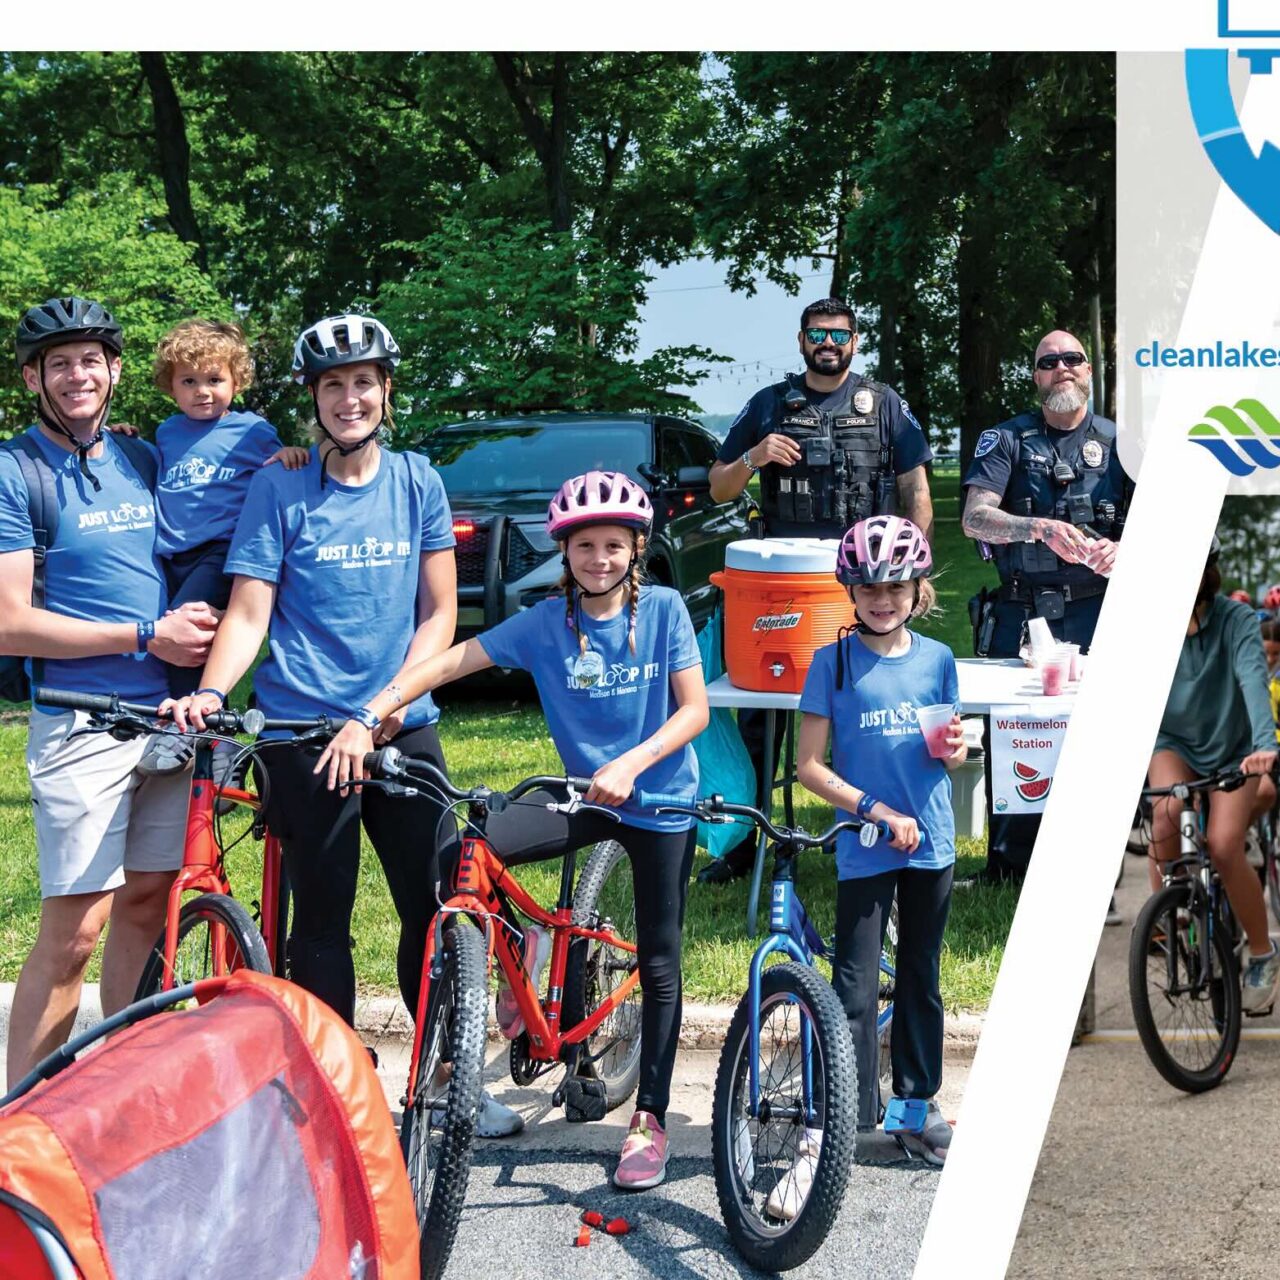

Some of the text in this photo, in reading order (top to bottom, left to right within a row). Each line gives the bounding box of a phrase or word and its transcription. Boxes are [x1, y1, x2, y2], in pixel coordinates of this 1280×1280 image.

[178, 463, 215, 478] LOOP
[78, 509, 109, 528] JUST
[111, 505, 148, 521] LOOP
[315, 541, 411, 562] JUST LOOP IT!
[598, 666, 639, 687] LOOP
[644, 662, 659, 680] IT!
[860, 709, 887, 728] JUST
[997, 719, 1067, 730] Watermelon
[1012, 738, 1053, 749] Station
